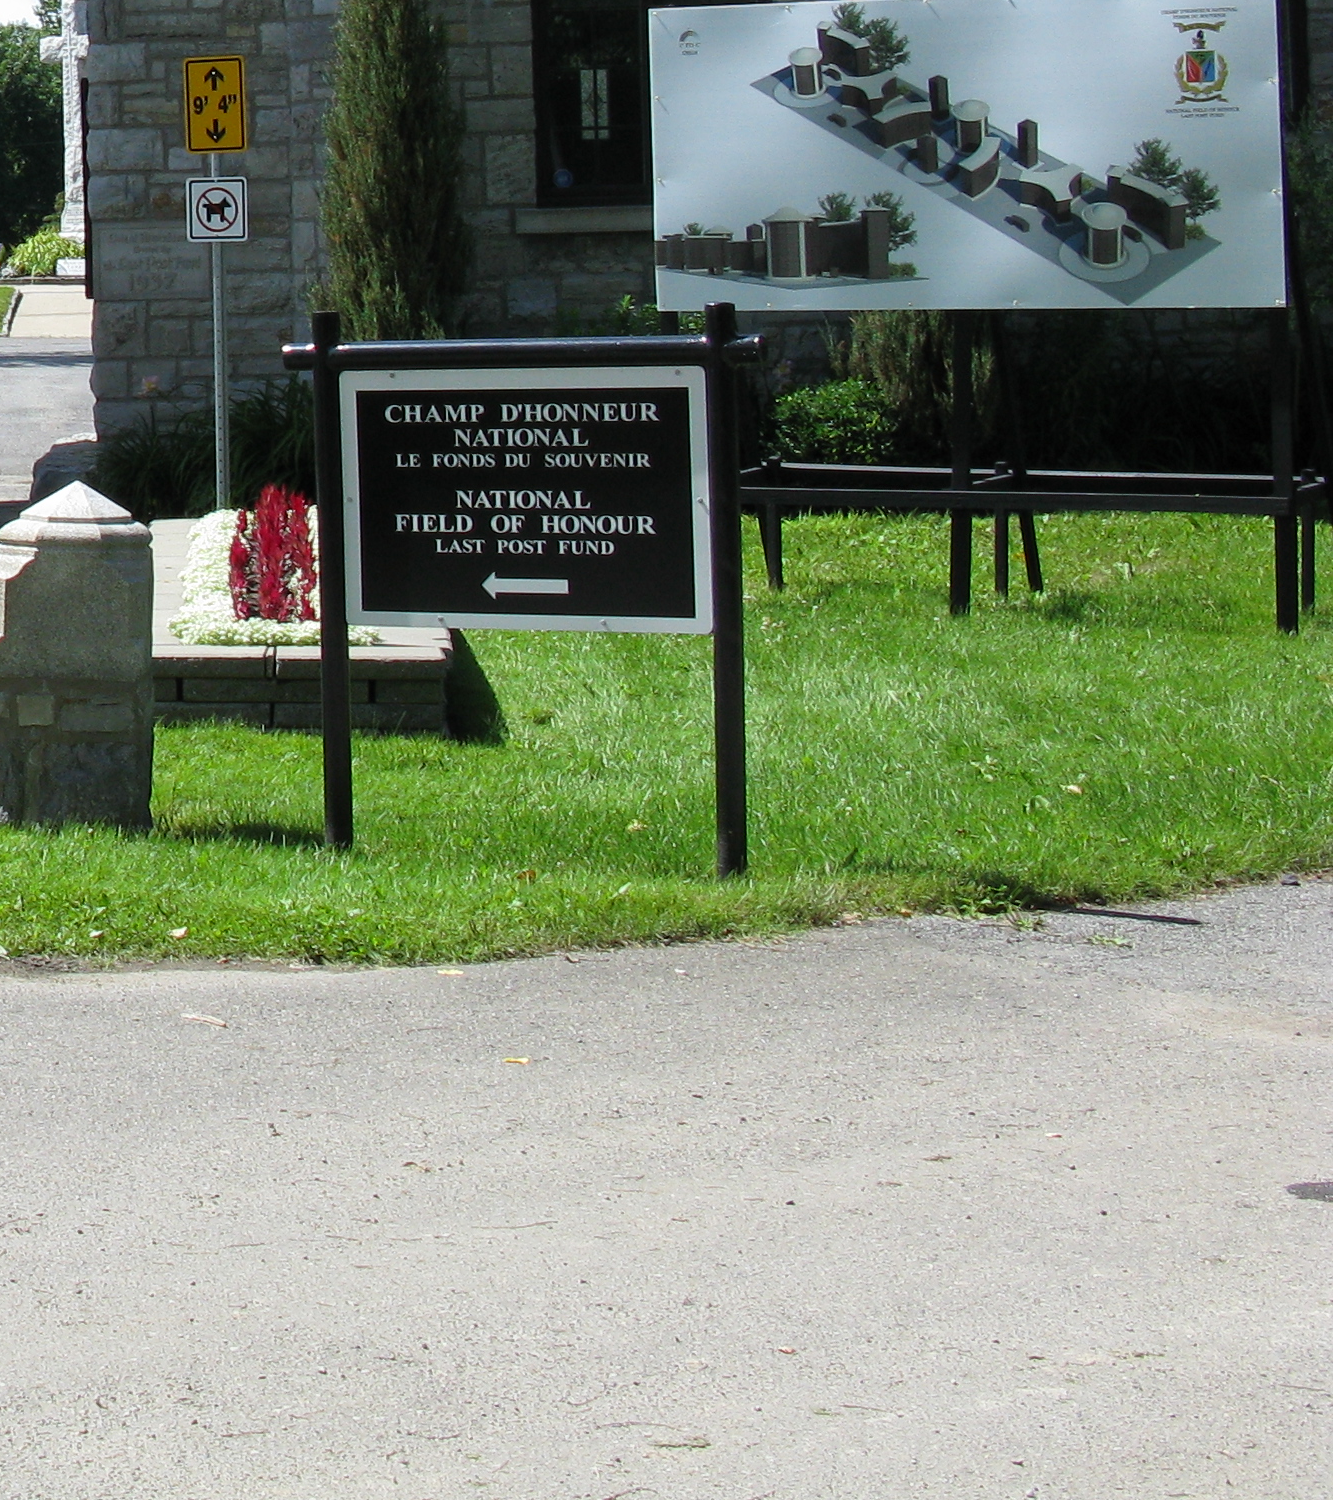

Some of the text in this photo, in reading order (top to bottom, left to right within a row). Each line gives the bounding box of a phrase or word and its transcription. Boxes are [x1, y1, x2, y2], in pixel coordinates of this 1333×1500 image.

[384, 403, 659, 423] CHAMP D'HONNEUR
[454, 428, 589, 447] NATIONAL
[396, 453, 651, 468] LE FONDS DU SOUVENIR
[456, 490, 591, 509] NATIONAL
[395, 514, 656, 534] FIELD OF HONOUR
[435, 539, 615, 555] LAST POST FUND
